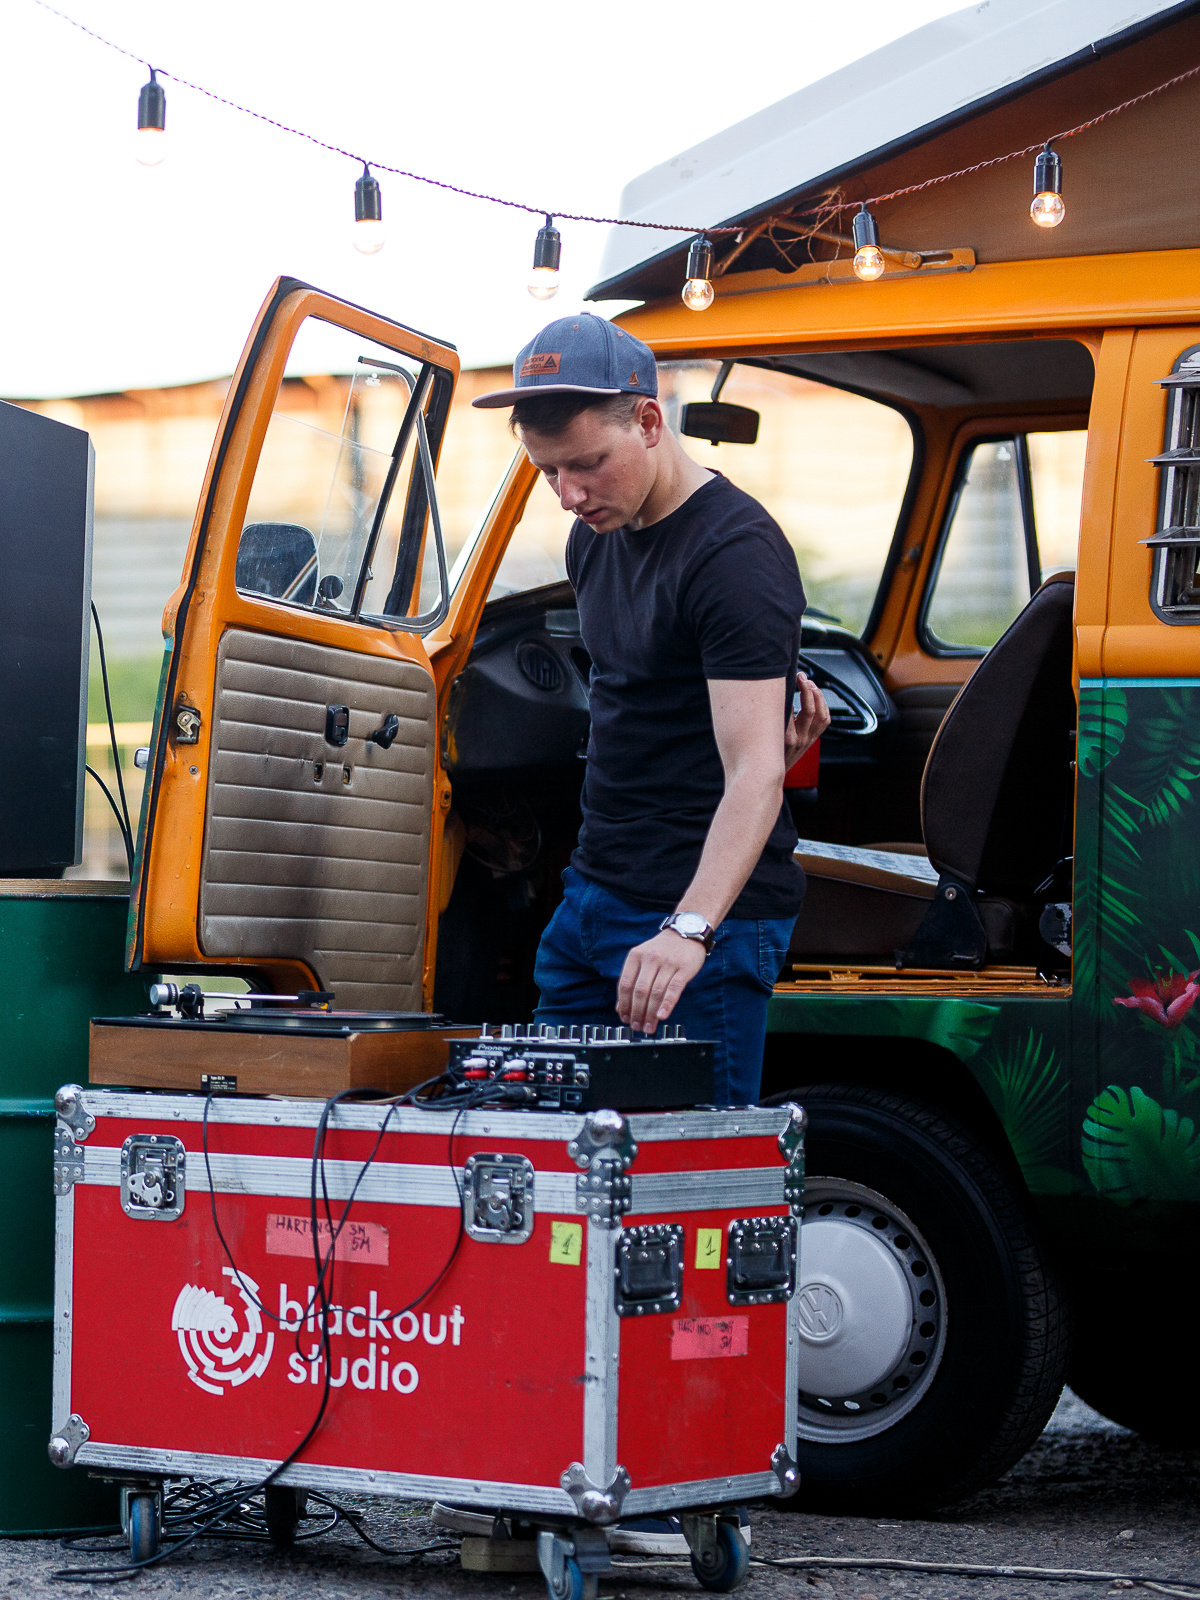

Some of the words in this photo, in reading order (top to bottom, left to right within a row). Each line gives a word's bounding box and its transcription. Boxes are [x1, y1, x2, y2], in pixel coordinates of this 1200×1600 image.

[478, 1043, 512, 1051] Pioneer
[351, 1236, 370, 1253] 5M
[705, 1235, 717, 1256] 1
[279, 1283, 465, 1346] blackout
[287, 1342, 419, 1394] studio
